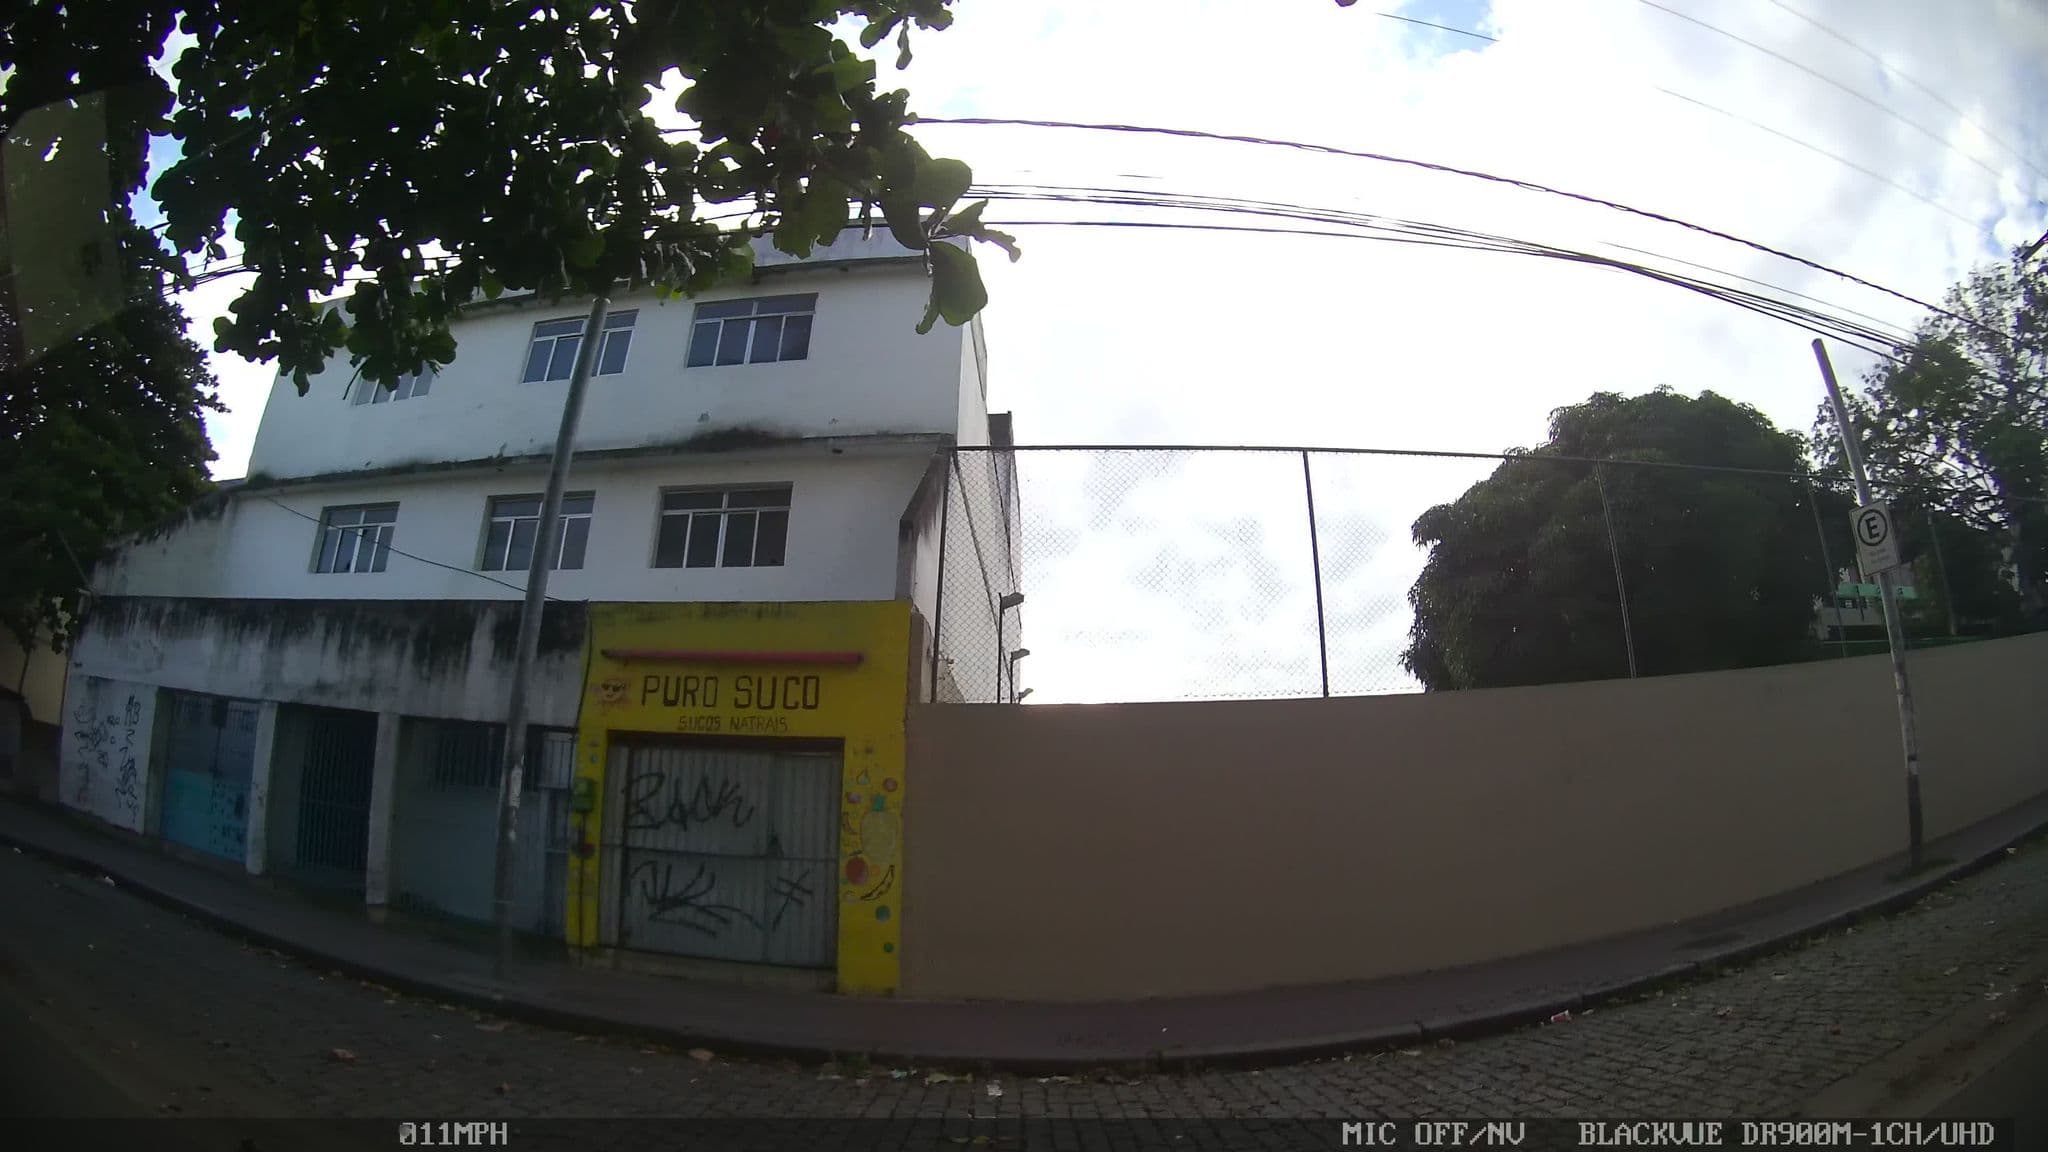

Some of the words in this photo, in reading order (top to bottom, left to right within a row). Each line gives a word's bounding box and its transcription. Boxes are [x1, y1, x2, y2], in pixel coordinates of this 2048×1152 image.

[1865, 516, 1880, 540] E
[640, 674, 719, 709] PURO
[733, 674, 821, 711] SUCO
[677, 715, 721, 732] SUCOS
